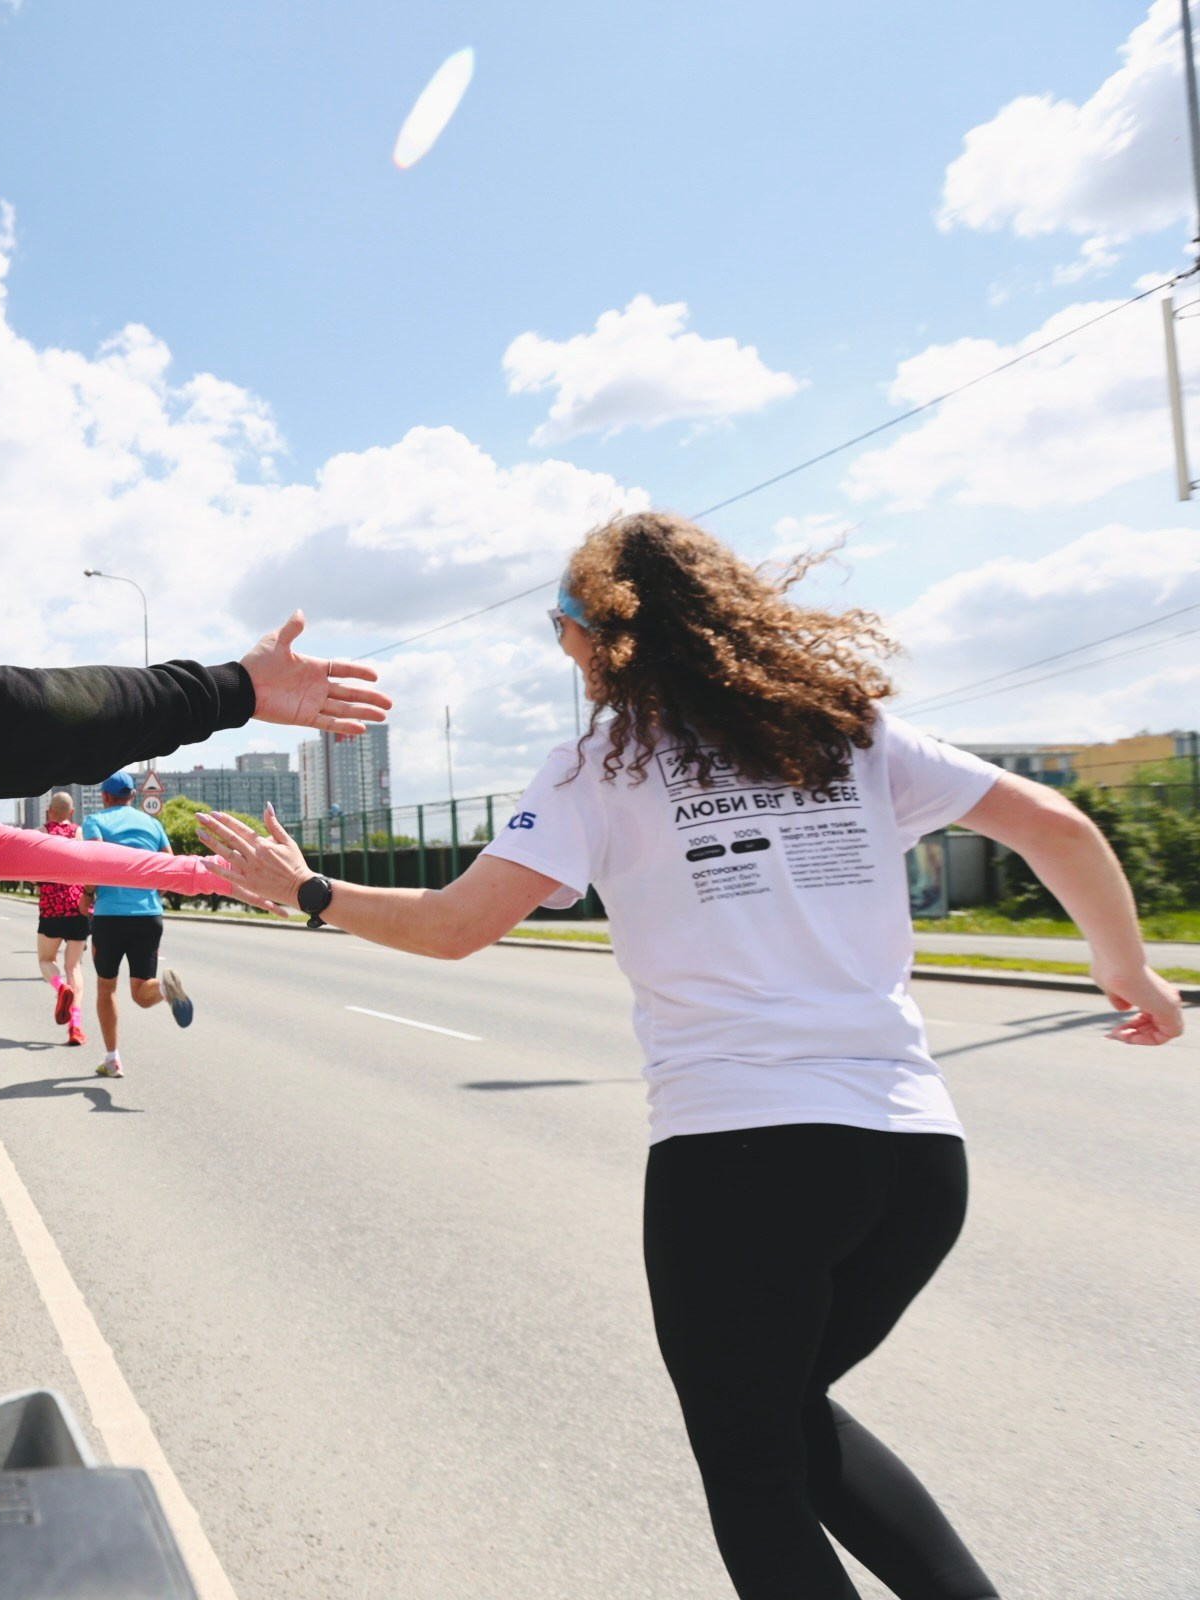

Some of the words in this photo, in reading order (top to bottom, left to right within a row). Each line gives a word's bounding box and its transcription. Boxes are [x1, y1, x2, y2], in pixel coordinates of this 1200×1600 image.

[146, 801, 158, 809] 40
[675, 793, 748, 823] ЛЮБИ
[752, 793, 786, 809] БЕГ
[792, 791, 805, 806] В
[811, 785, 860, 805] СЕБЕ
[688, 834, 719, 847] 100%
[734, 828, 763, 839] 100%
